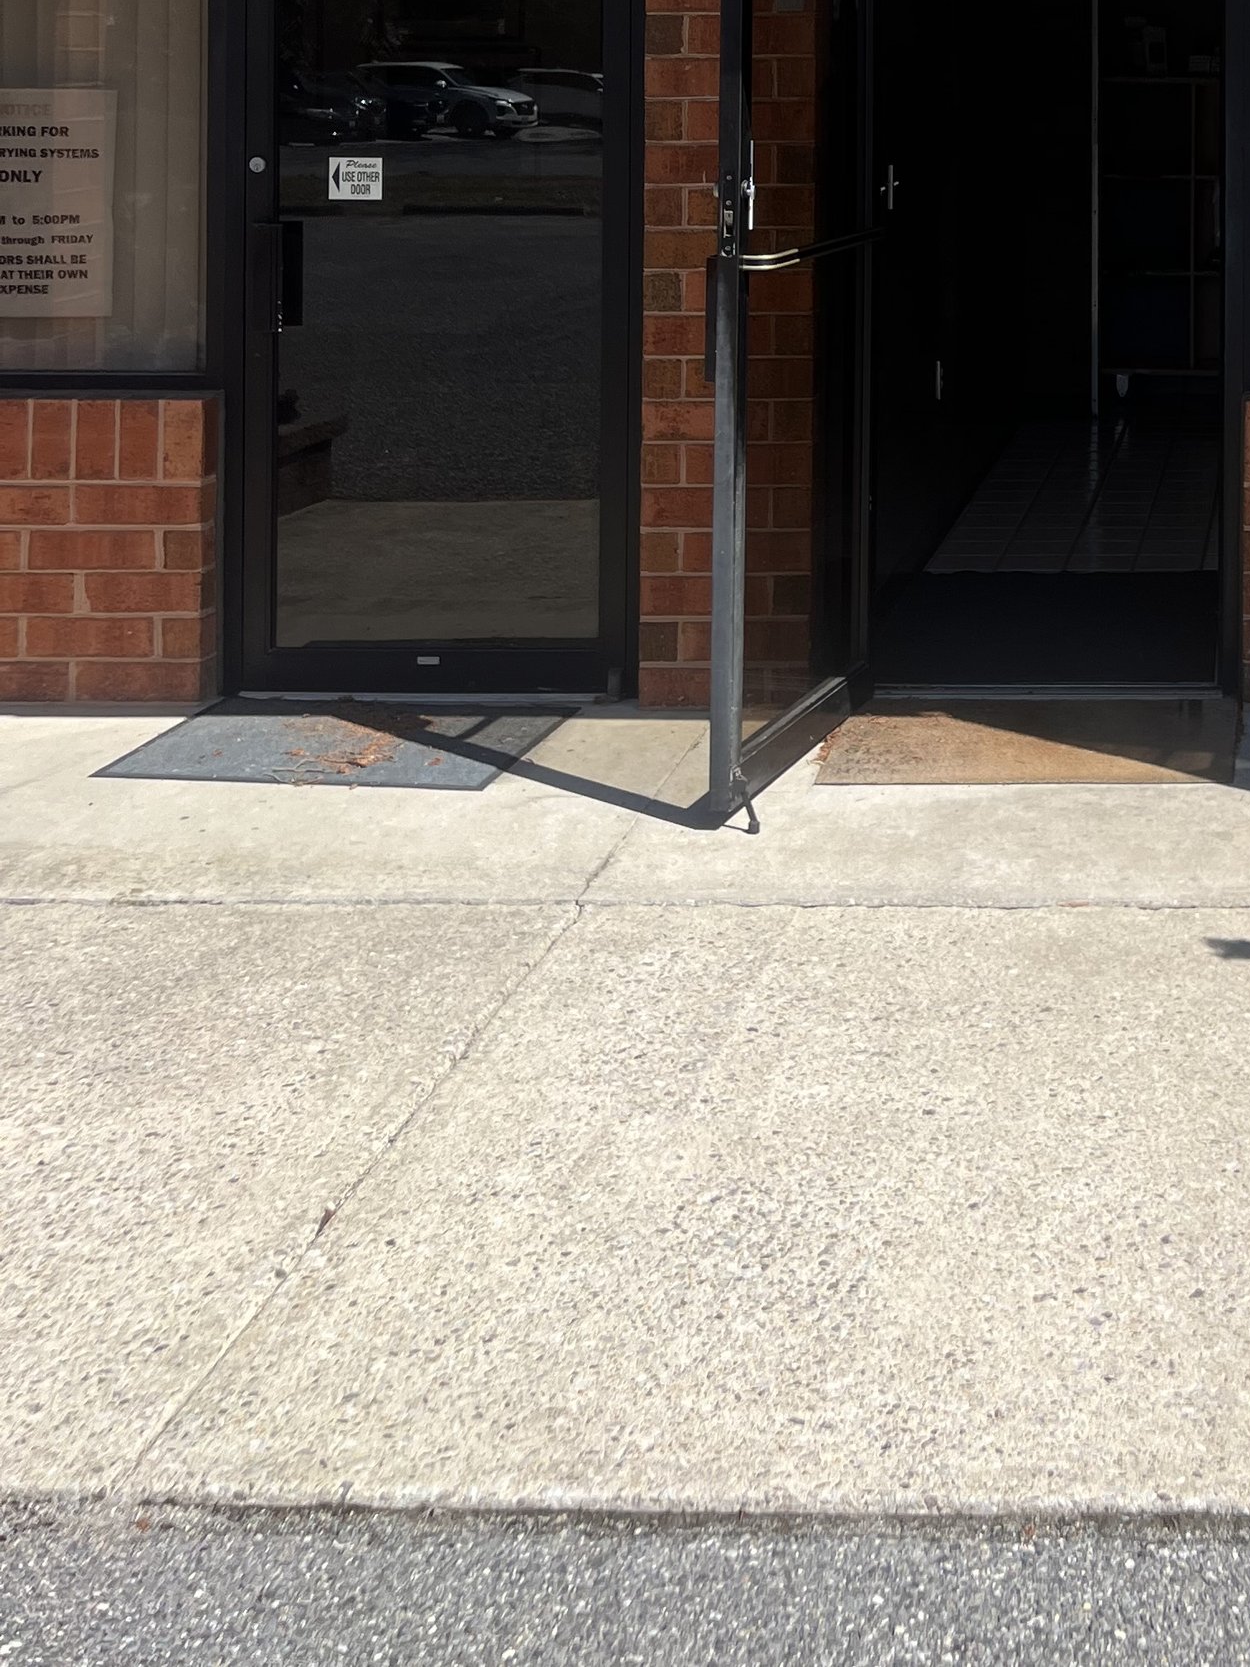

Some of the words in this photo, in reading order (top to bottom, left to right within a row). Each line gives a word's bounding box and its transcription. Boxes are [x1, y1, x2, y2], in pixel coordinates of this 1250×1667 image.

[0, 126, 36, 137] KING
[41, 126, 69, 137] FOR
[40, 148, 100, 159] SYSTEMS
[346, 160, 377, 168] Please
[0, 170, 42, 183] ONLY
[342, 171, 356, 182] USE
[356, 171, 380, 182] OTHER
[350, 184, 371, 195] DOOR
[12, 215, 26, 225] to
[32, 214, 81, 225] 5:00PM
[1, 236, 45, 247] through
[51, 234, 94, 245] FRIDAY
[26, 255, 67, 265] SHALL
[70, 254, 87, 265] BE
[1, 270, 15, 280] AT
[17, 270, 54, 280] THEIR
[58, 269, 88, 280] OWN
